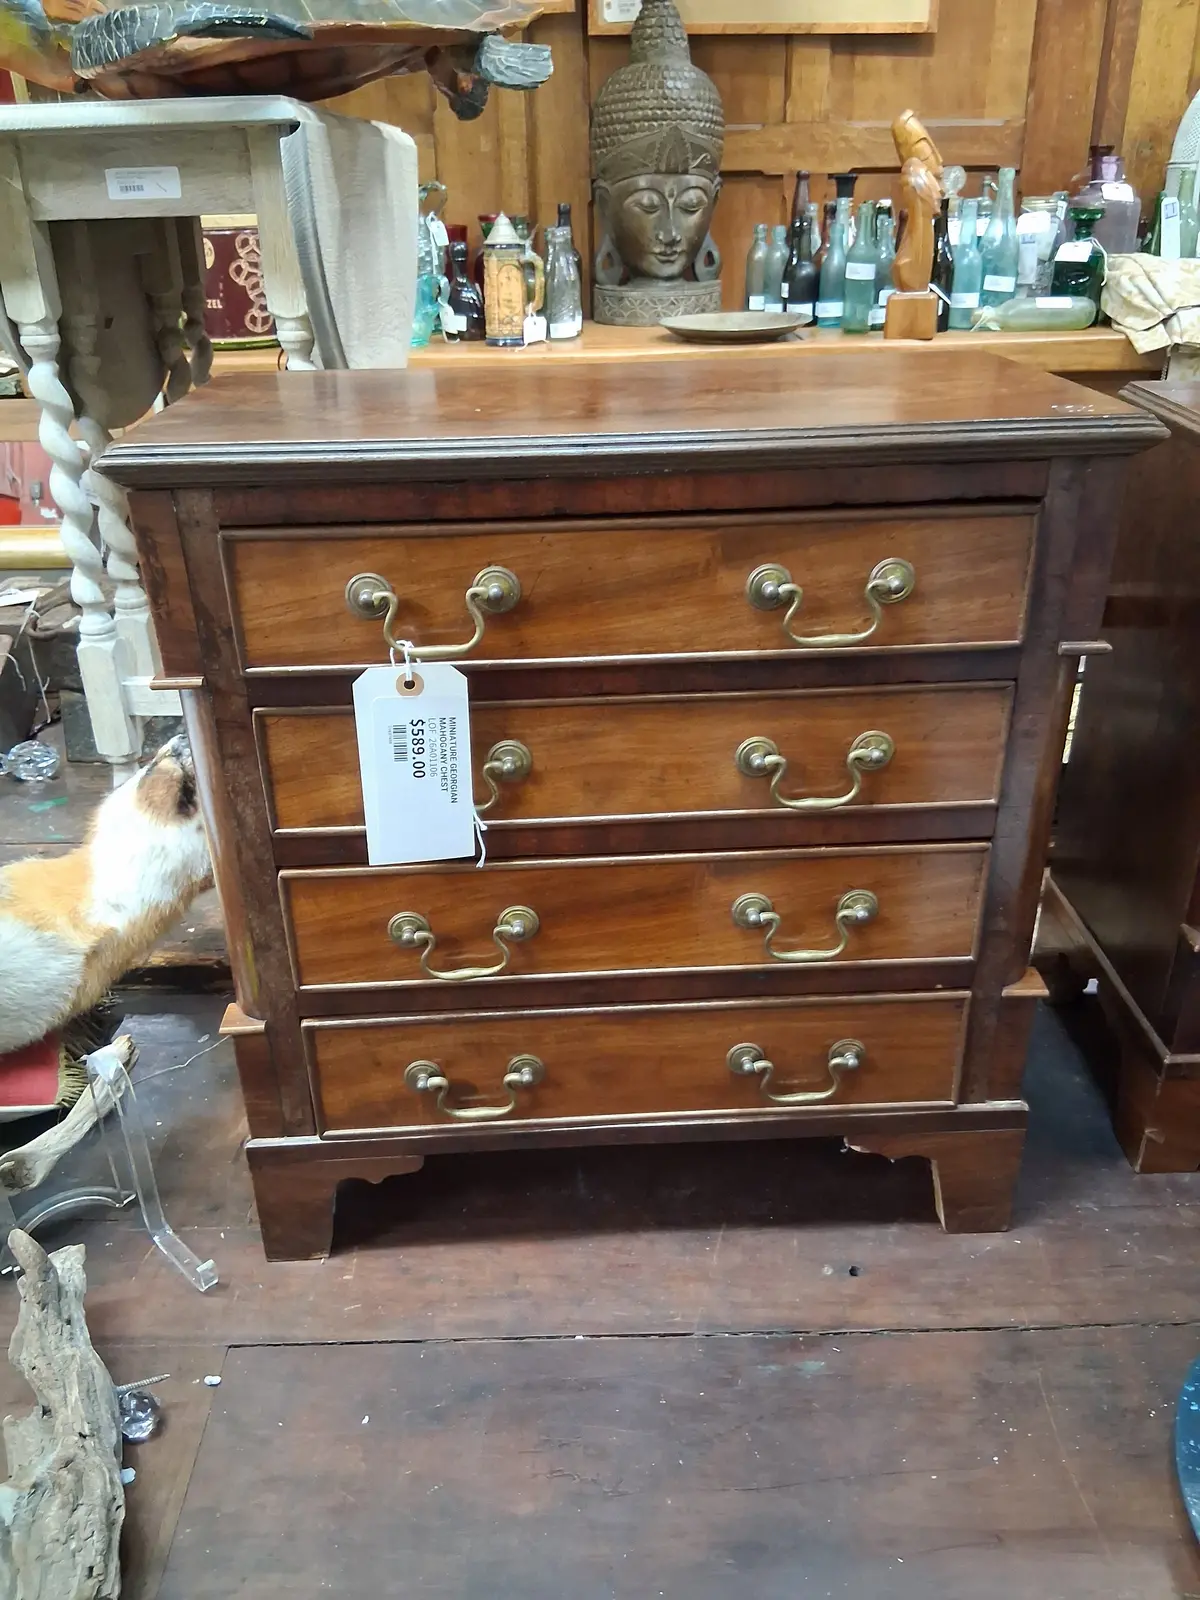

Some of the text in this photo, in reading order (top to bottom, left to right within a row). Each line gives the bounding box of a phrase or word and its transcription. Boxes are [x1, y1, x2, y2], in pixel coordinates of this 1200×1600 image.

[409, 719, 426, 779] $589.00
[428, 717, 437, 734] LOF
[439, 717, 449, 792] MAHOGANY CHEST
[449, 716, 458, 804] MINIATURE GEORGIAN
